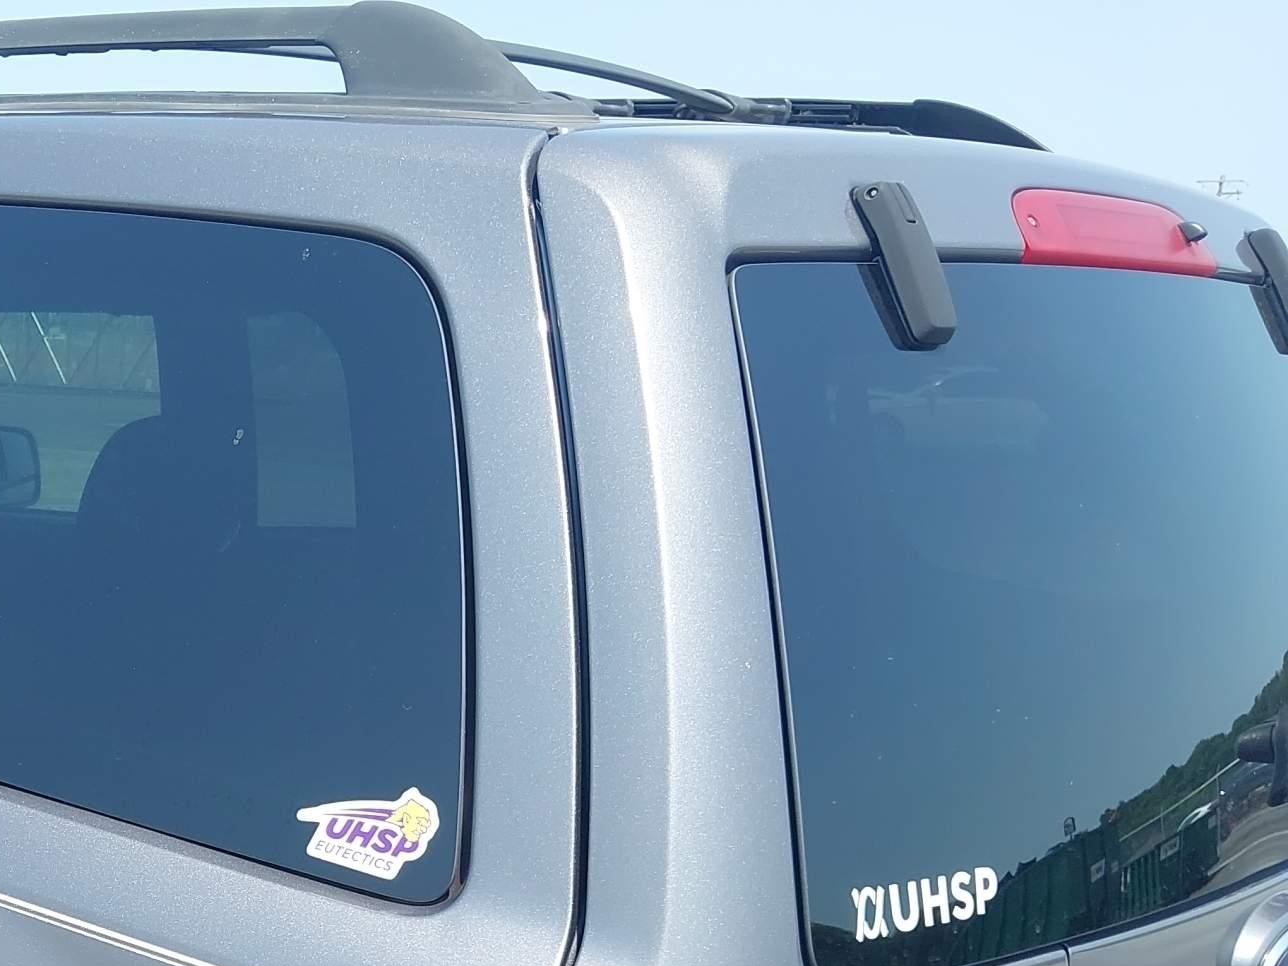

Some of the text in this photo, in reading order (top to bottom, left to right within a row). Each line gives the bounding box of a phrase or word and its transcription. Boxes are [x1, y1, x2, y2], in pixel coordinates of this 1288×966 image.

[314, 840, 394, 871] EUTECTICS
[325, 817, 420, 858] UHSP
[888, 866, 999, 932] UHSP
